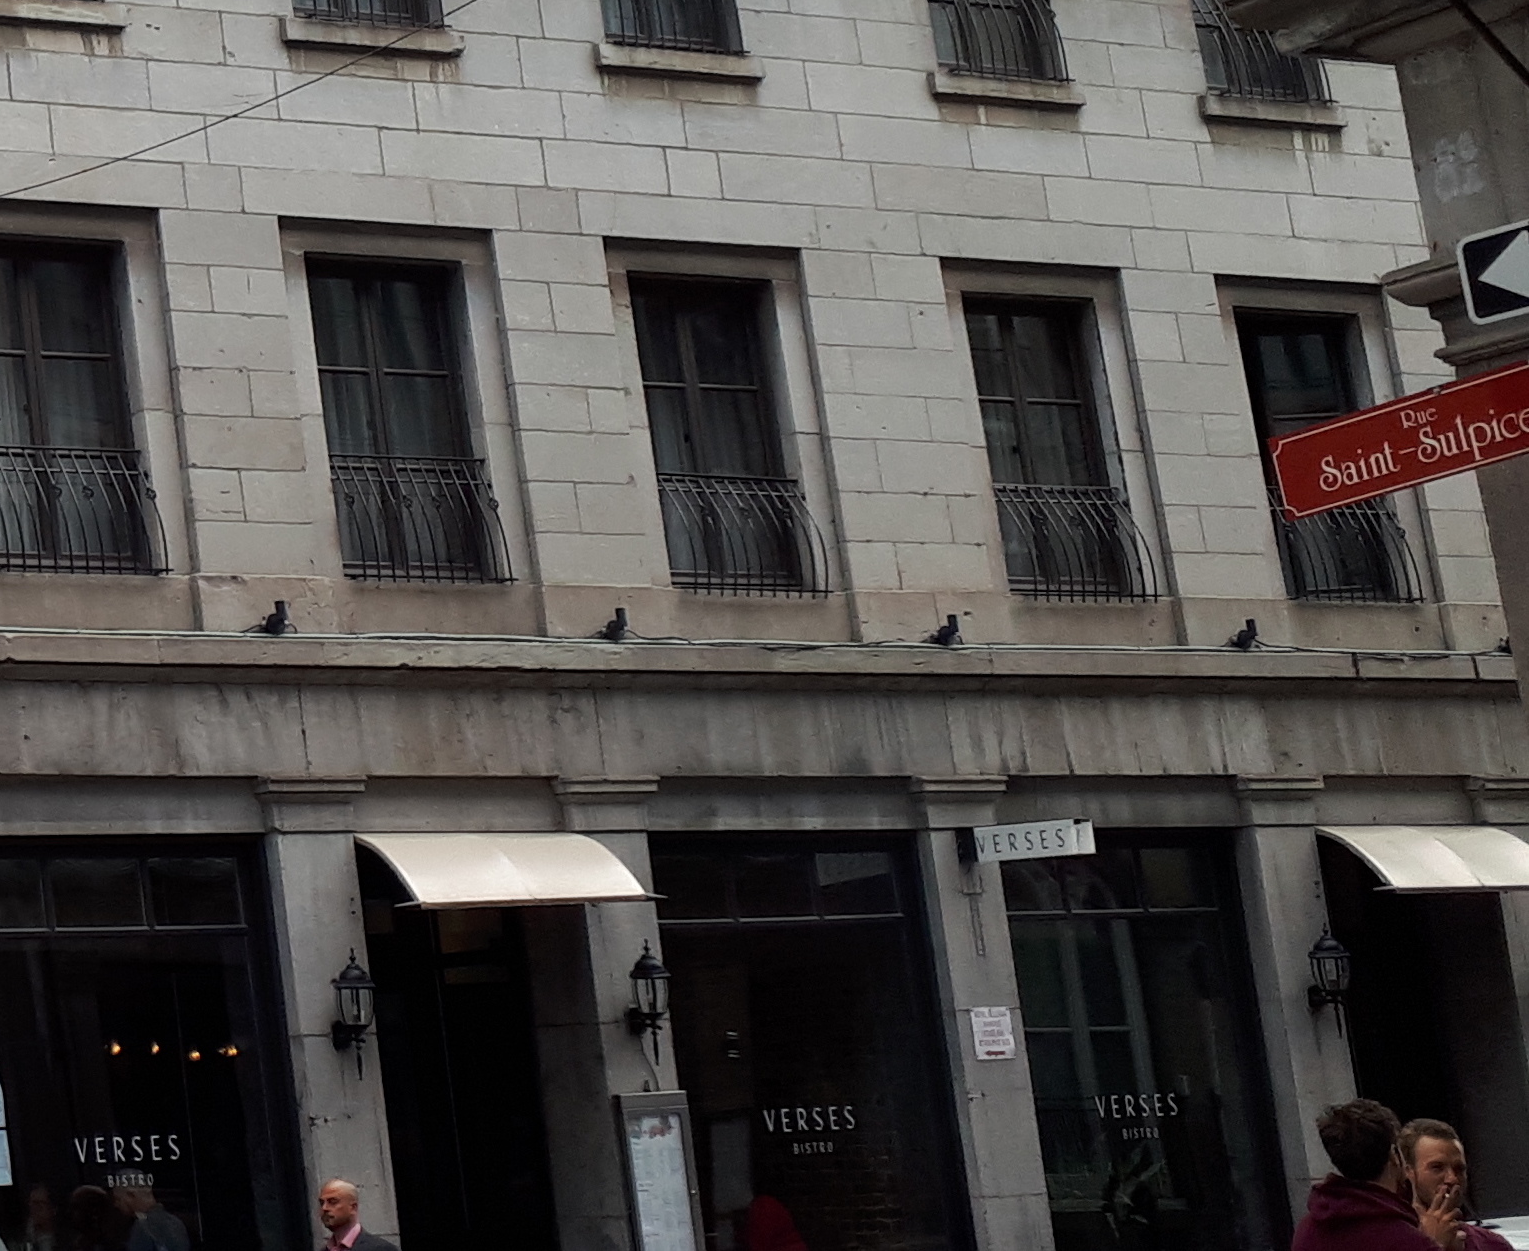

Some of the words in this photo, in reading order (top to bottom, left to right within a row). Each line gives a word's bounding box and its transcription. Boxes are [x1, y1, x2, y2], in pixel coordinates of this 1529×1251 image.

[1400, 408, 1439, 429] Rue
[976, 828, 1065, 854] VERSES
[763, 1105, 856, 1133] VERSES
[1095, 1093, 1179, 1119] VERSES
[74, 1134, 181, 1163] VERSES
[107, 1173, 154, 1188] BISTRO
